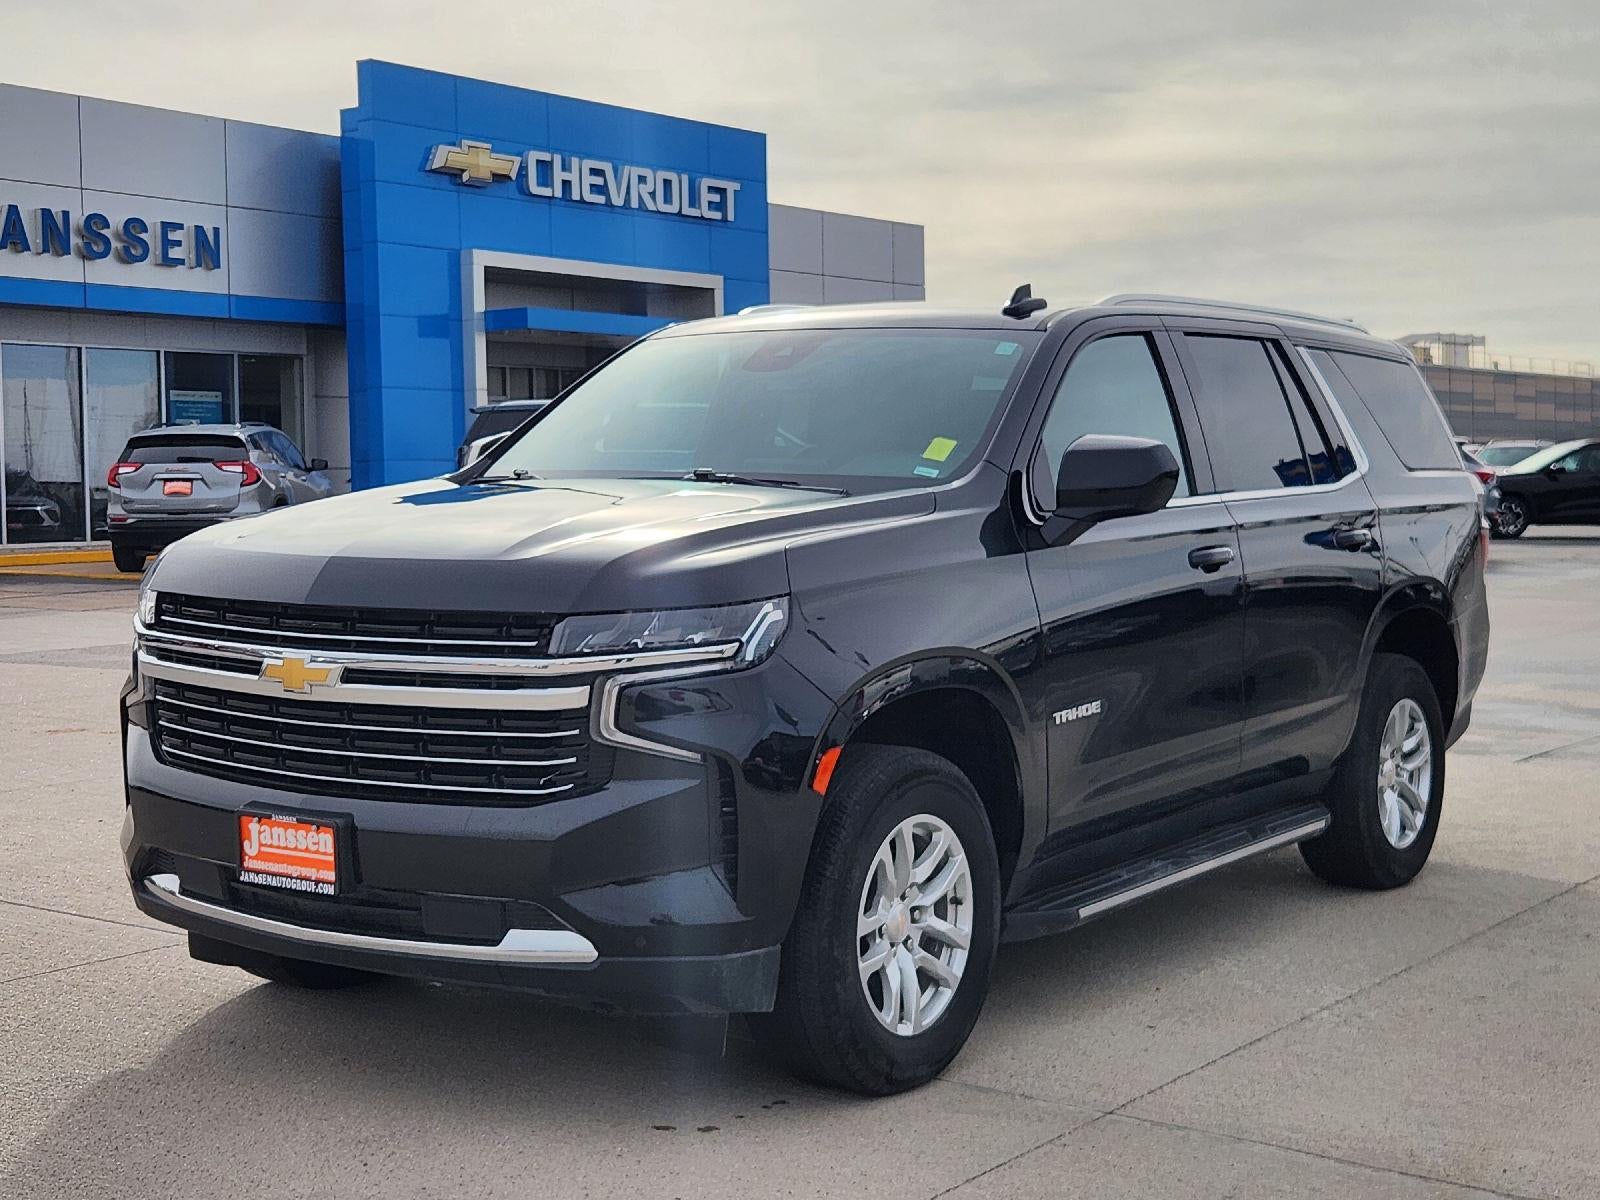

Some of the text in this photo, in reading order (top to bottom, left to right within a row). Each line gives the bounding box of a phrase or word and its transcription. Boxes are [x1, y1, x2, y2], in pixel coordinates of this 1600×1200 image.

[527, 150, 741, 222] CHEVROLET
[1052, 699, 1102, 725] TAHOE
[239, 870, 335, 895] JANSSENAUTOGROUP.COM
